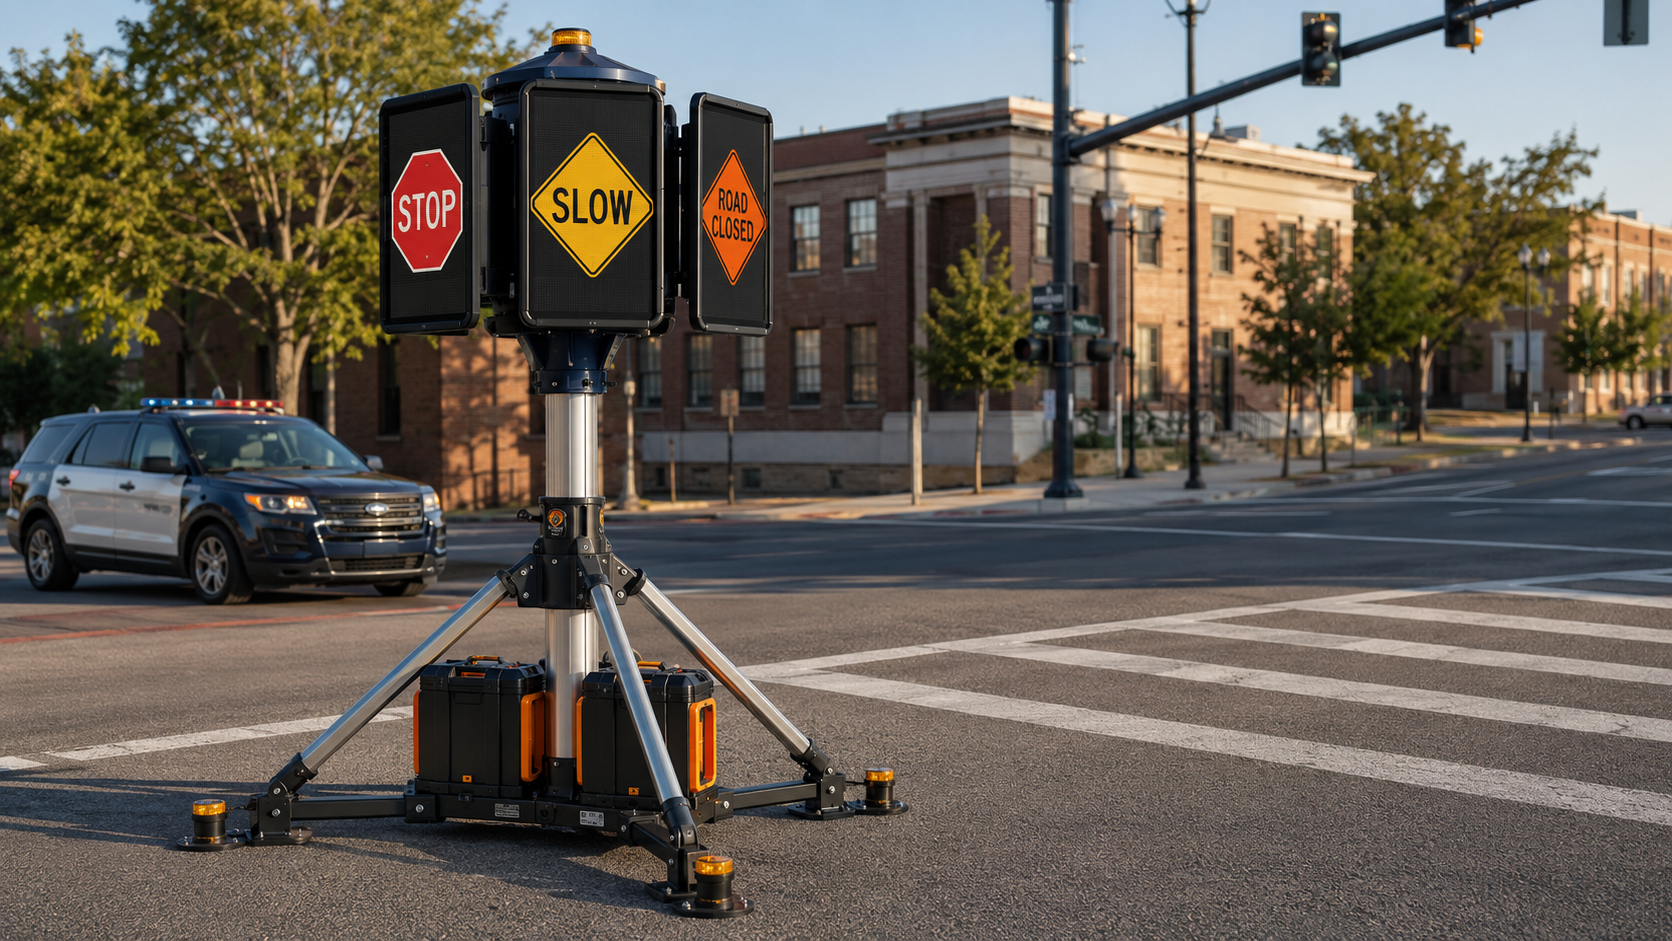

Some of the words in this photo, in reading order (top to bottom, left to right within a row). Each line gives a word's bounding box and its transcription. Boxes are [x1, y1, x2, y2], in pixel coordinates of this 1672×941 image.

[398, 189, 456, 232] STOP
[552, 187, 633, 225] SLOW
[718, 188, 748, 214] ROAD
[712, 215, 754, 242] CLOSED
